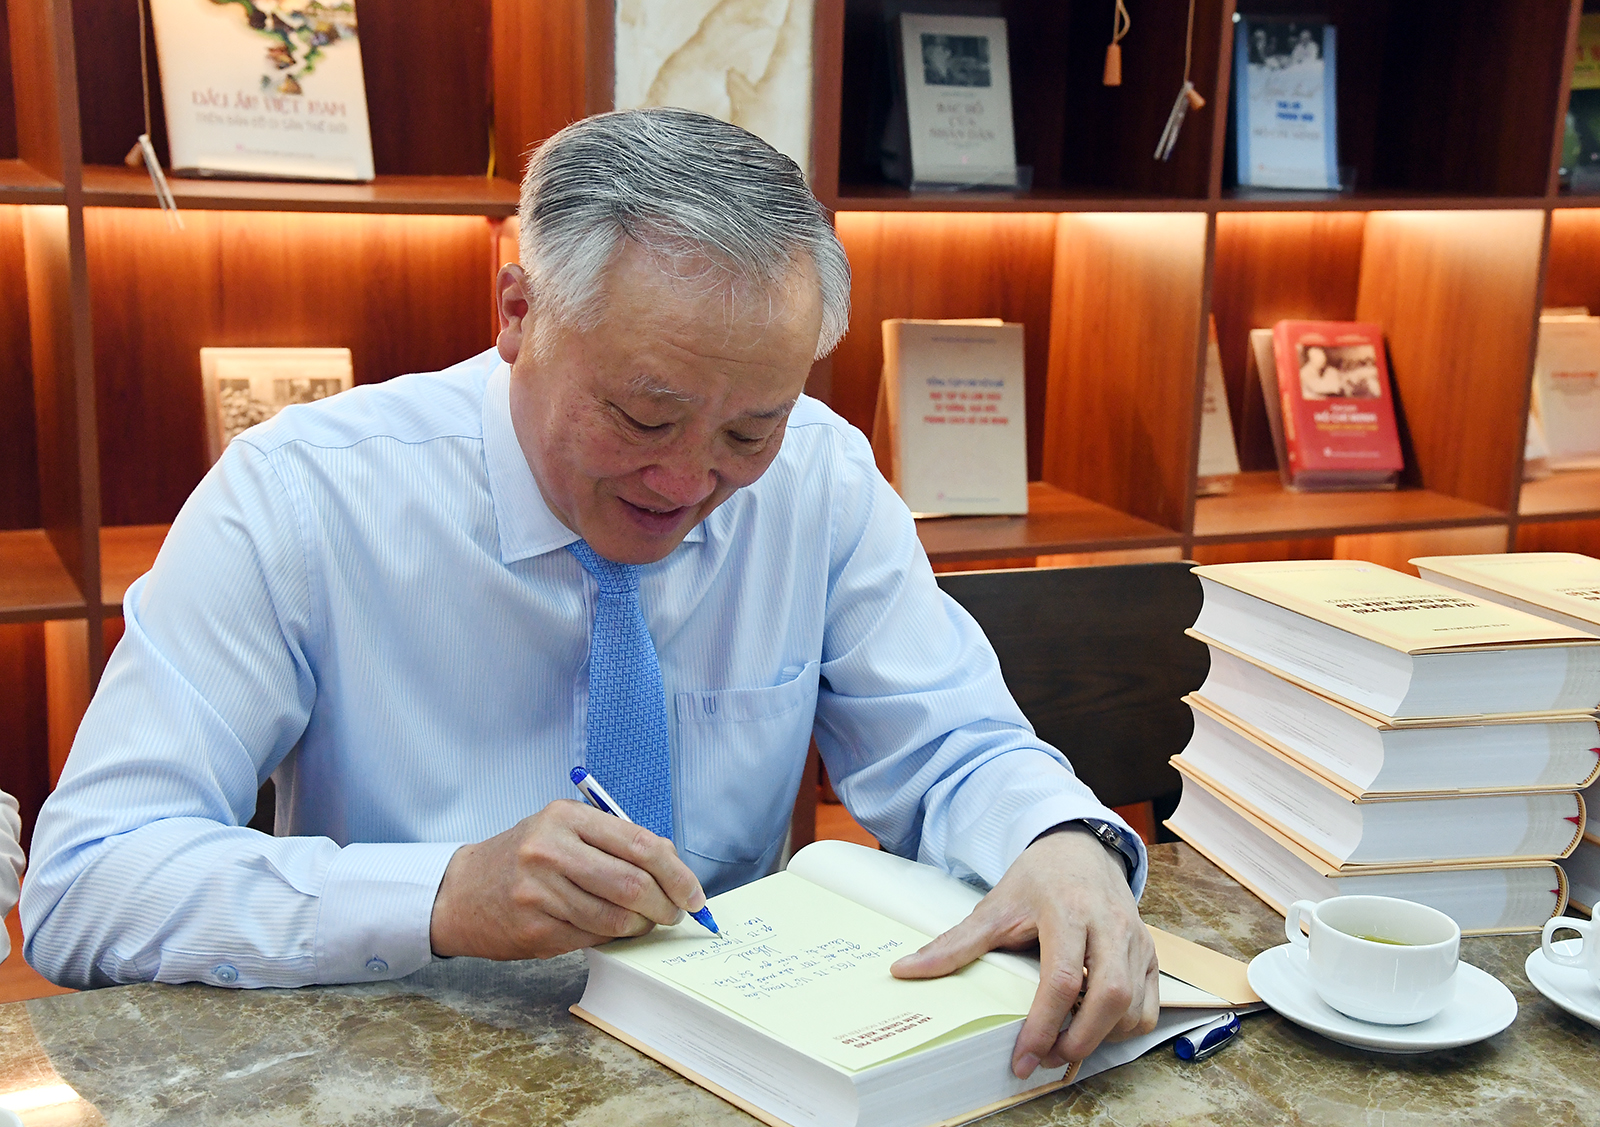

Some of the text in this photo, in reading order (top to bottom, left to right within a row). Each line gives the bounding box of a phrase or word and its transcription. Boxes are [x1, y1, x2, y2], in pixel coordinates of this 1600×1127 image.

[895, 1022, 918, 1033] DỰNG
[870, 1032, 896, 1042] CHÍNH
[854, 1040, 872, 1049] PHỦ
